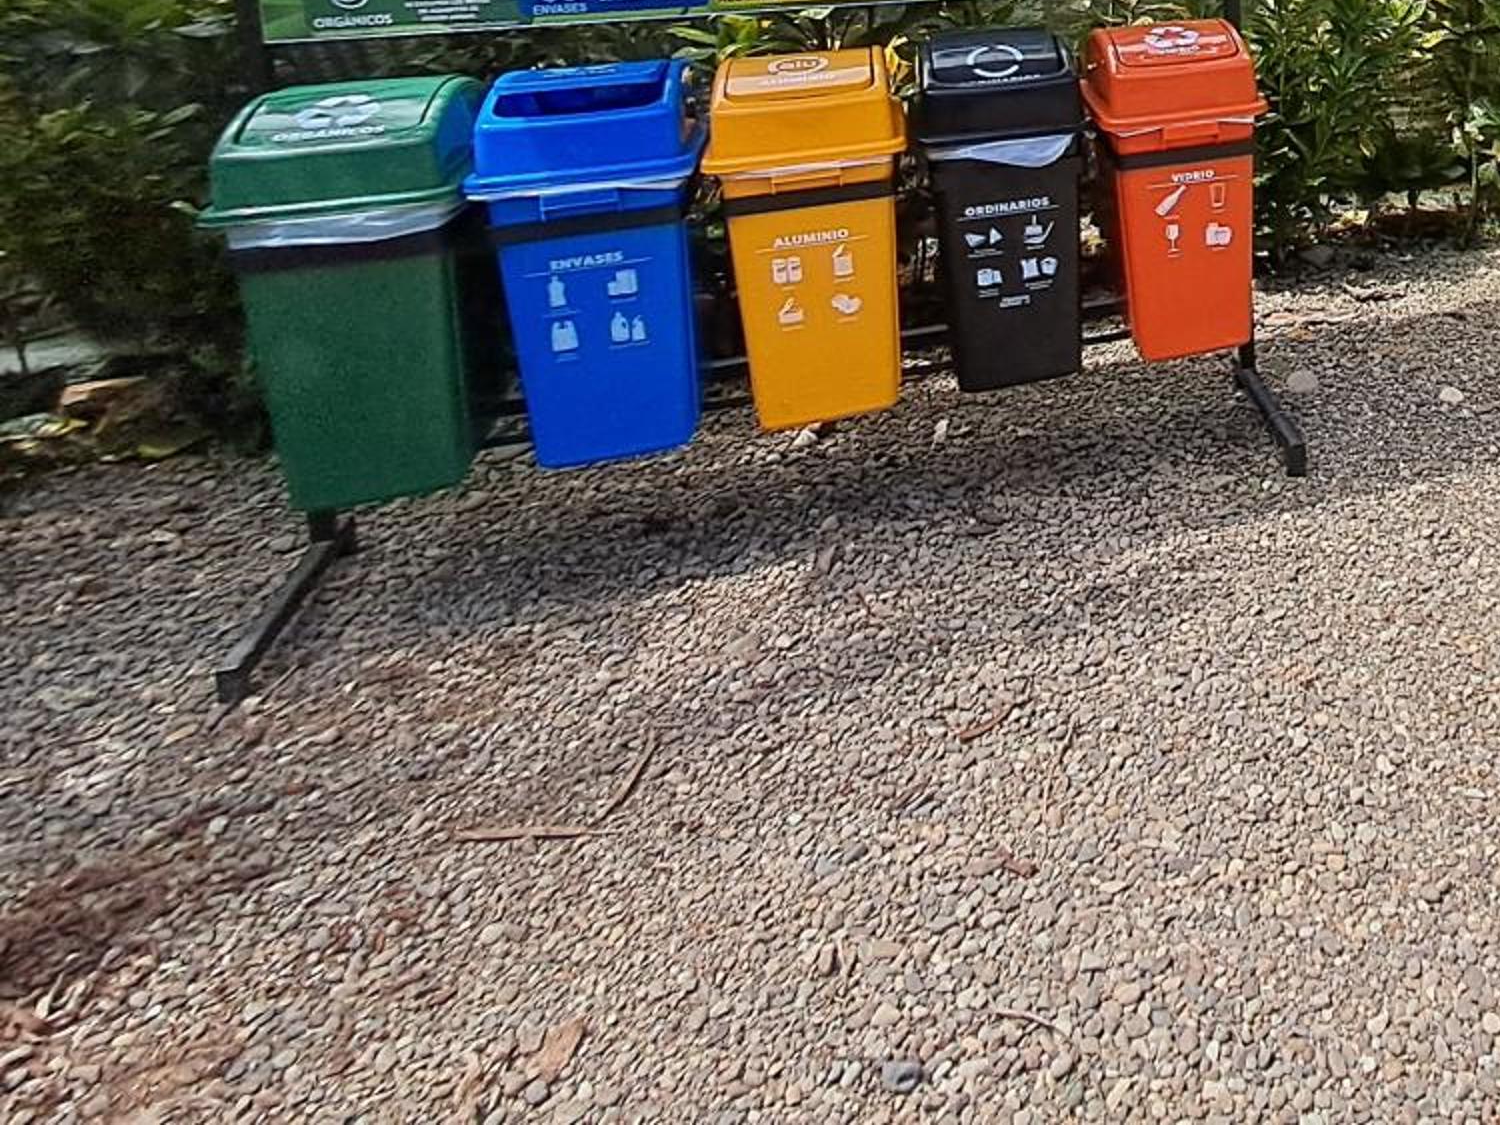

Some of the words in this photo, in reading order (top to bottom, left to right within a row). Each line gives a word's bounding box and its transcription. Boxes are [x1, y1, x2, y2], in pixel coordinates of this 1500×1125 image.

[1171, 169, 1215, 183] VIDRIO
[965, 196, 1050, 216] ORDINARIOS
[774, 228, 849, 249] ALUMINIO
[549, 251, 624, 271] ENVASES
